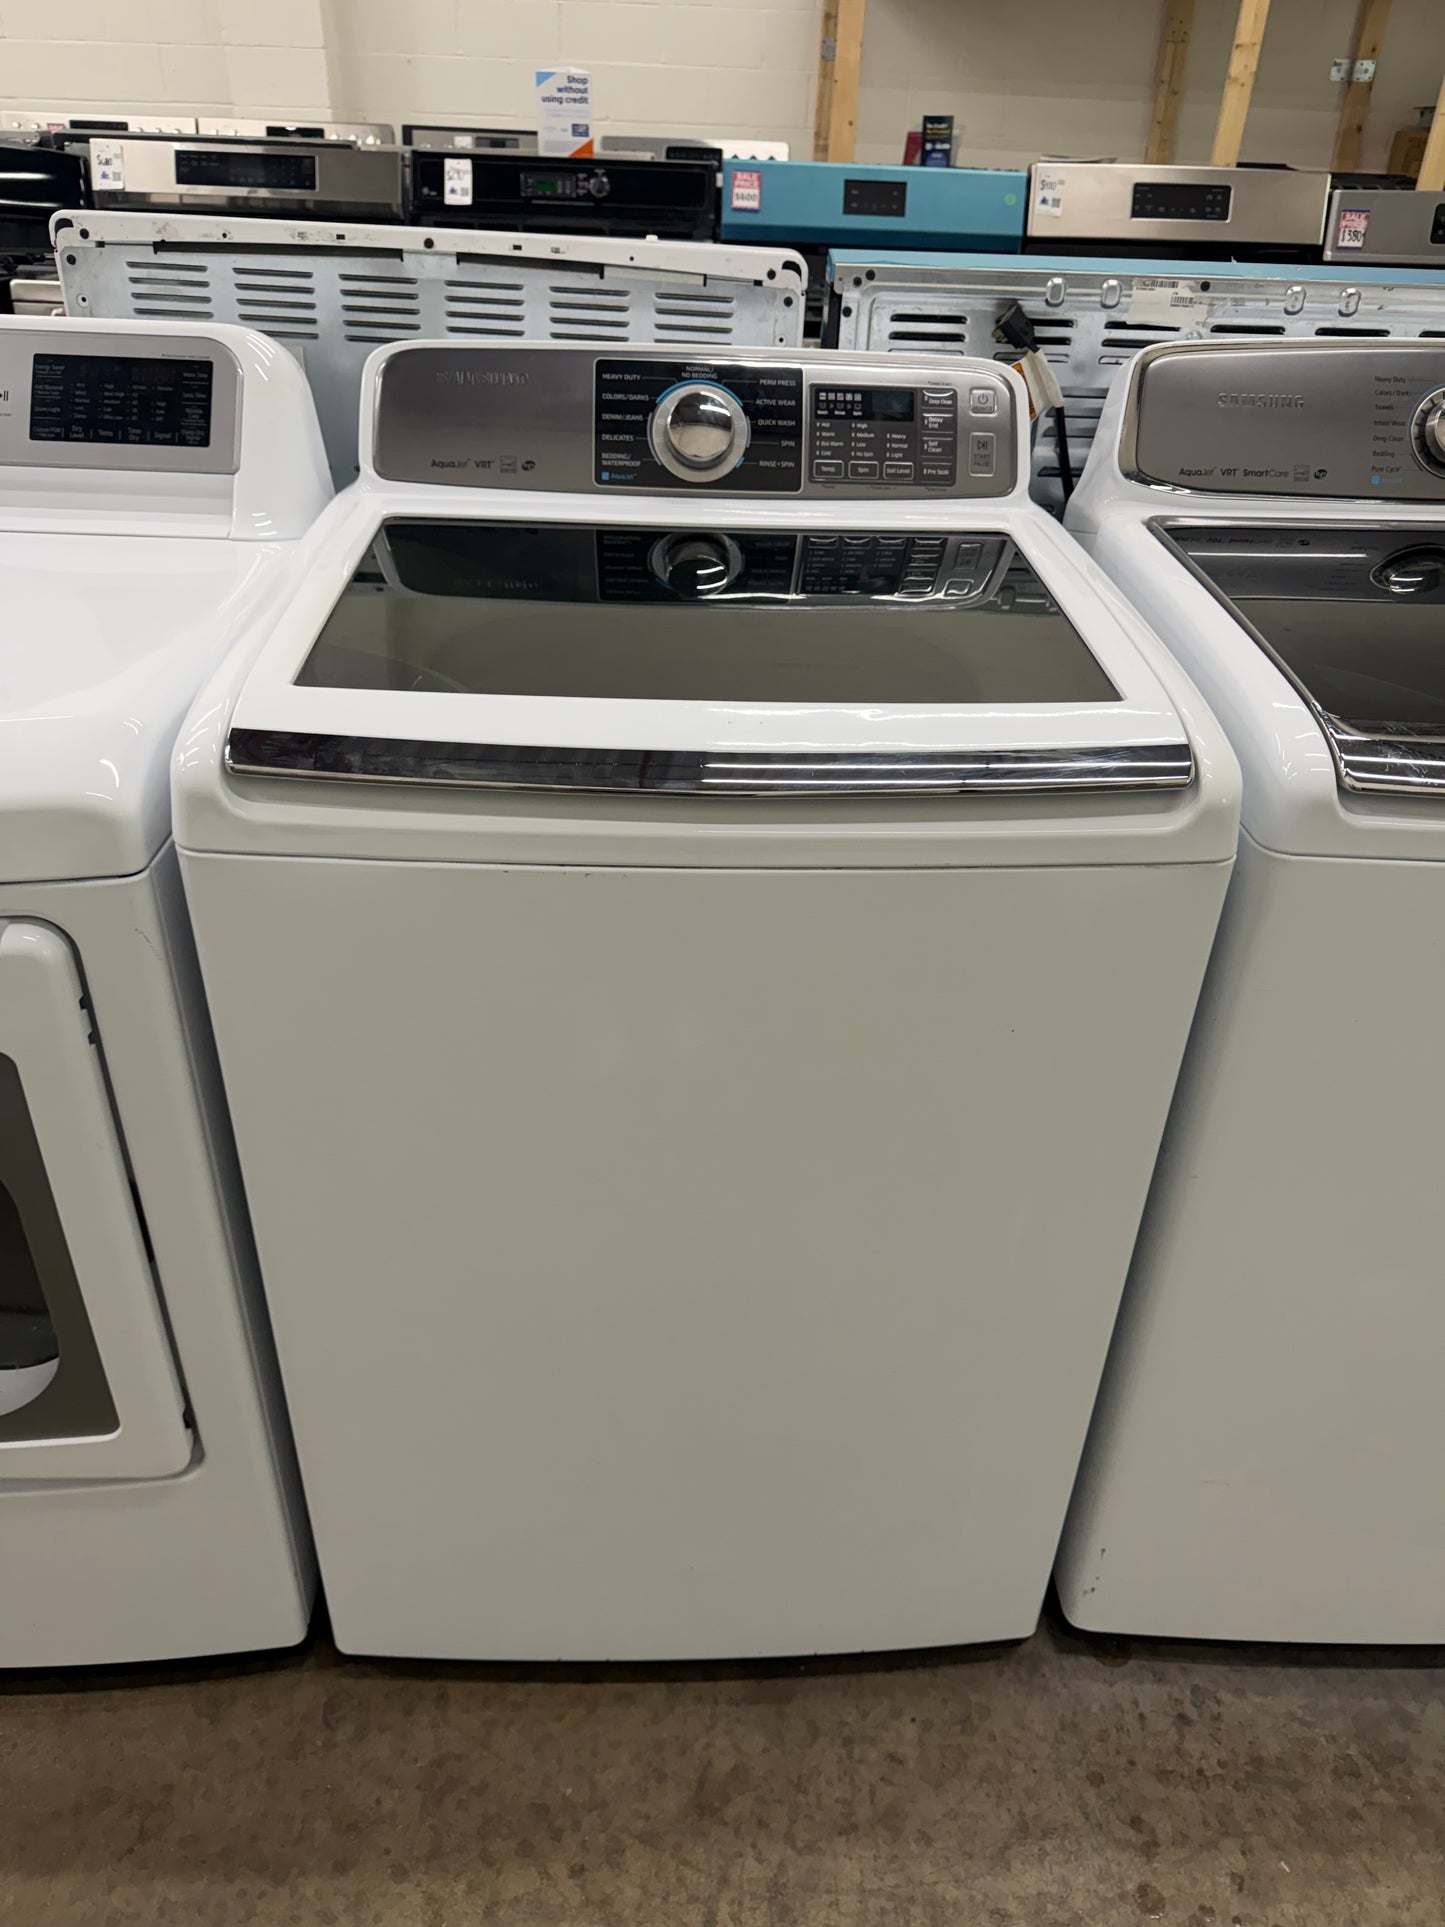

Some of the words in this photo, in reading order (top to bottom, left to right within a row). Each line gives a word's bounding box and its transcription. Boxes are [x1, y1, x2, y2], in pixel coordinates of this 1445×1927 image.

[567, 76, 588, 85] Shop
[541, 95, 563, 105] using
[565, 96, 588, 104] credit
[736, 172, 758, 180] SALE
[1345, 212, 1365, 220] SALE
[692, 372, 718, 380] BEDDING
[602, 392, 650, 401] COLORS/DARKS
[1218, 392, 1304, 408] SAMSUNG
[756, 398, 777, 406] ACTIVE
[928, 398, 940, 406] Deep
[778, 420, 796, 428] WASH
[928, 416, 944, 424] Delay
[72, 425, 83, 433] Dry
[856, 422, 868, 430] High
[128, 434, 140, 442] Dry
[154, 432, 172, 440] Signal
[602, 434, 634, 442] DELICATES
[780, 440, 796, 448] SPIN
[602, 452, 632, 460] BEDDING/
[1372, 450, 1395, 458] Bedding
[857, 466, 870, 474] Spin
[1243, 468, 1290, 478] SmartCare
